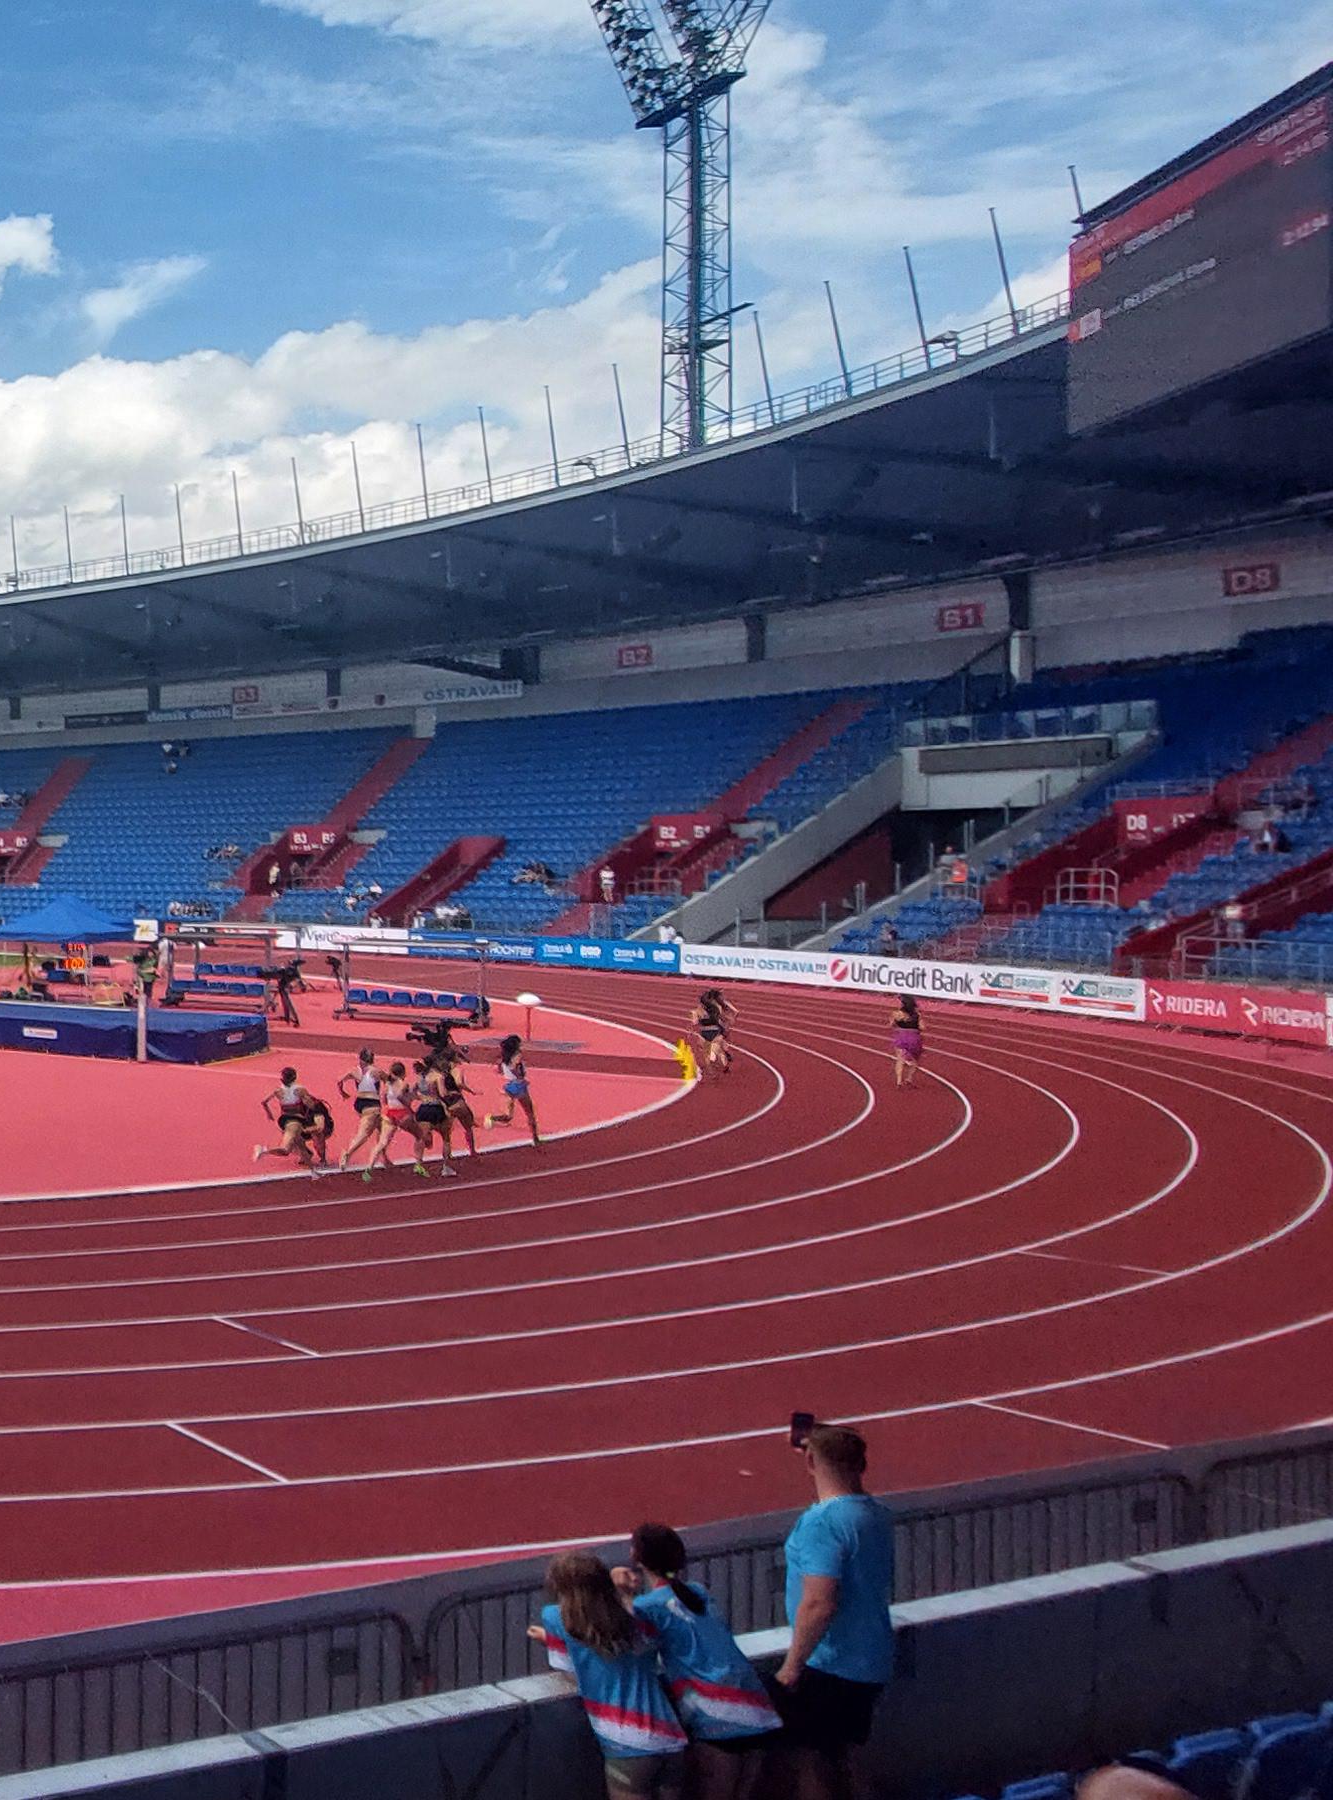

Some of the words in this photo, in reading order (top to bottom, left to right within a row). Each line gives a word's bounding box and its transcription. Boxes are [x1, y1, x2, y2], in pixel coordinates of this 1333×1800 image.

[684, 954, 755, 968] OSTRAVA!!!
[757, 958, 827, 974] OSTRAVA!!!
[851, 964, 927, 990] UniCredit
[932, 968, 974, 995] Bank
[1165, 995, 1227, 1018] RIDERA
